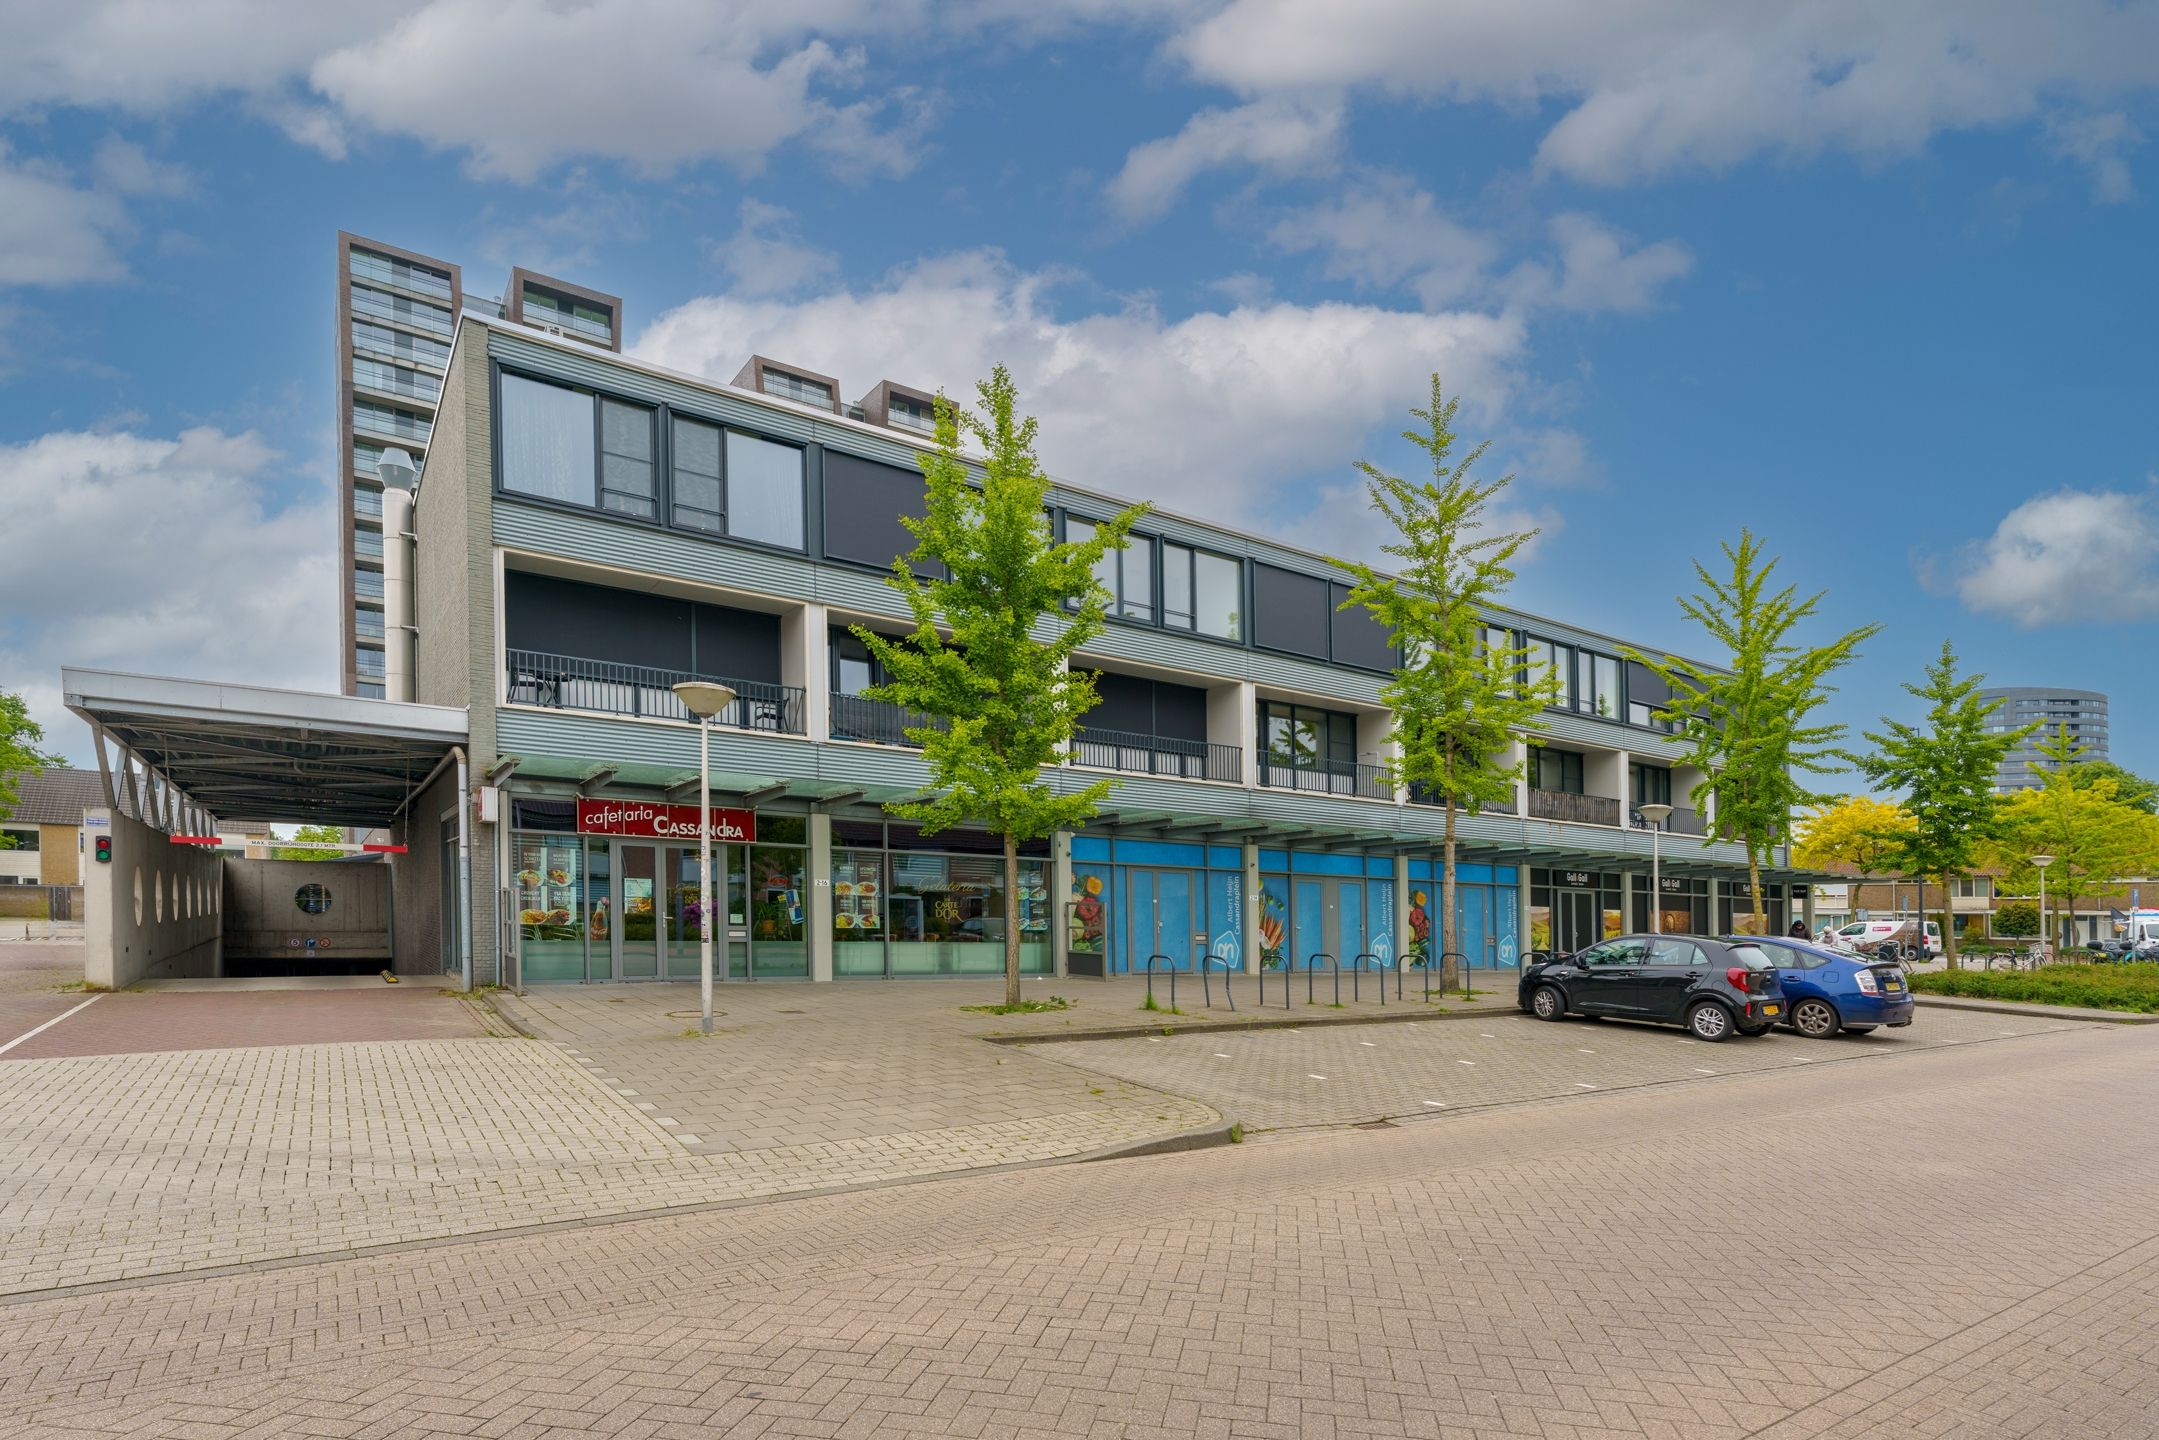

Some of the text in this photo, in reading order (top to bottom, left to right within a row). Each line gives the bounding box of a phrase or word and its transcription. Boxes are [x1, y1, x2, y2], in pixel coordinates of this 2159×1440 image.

[585, 805, 652, 829] cafetaria
[1226, 876, 1234, 897] Heijn
[935, 900, 959, 909] CARTE
